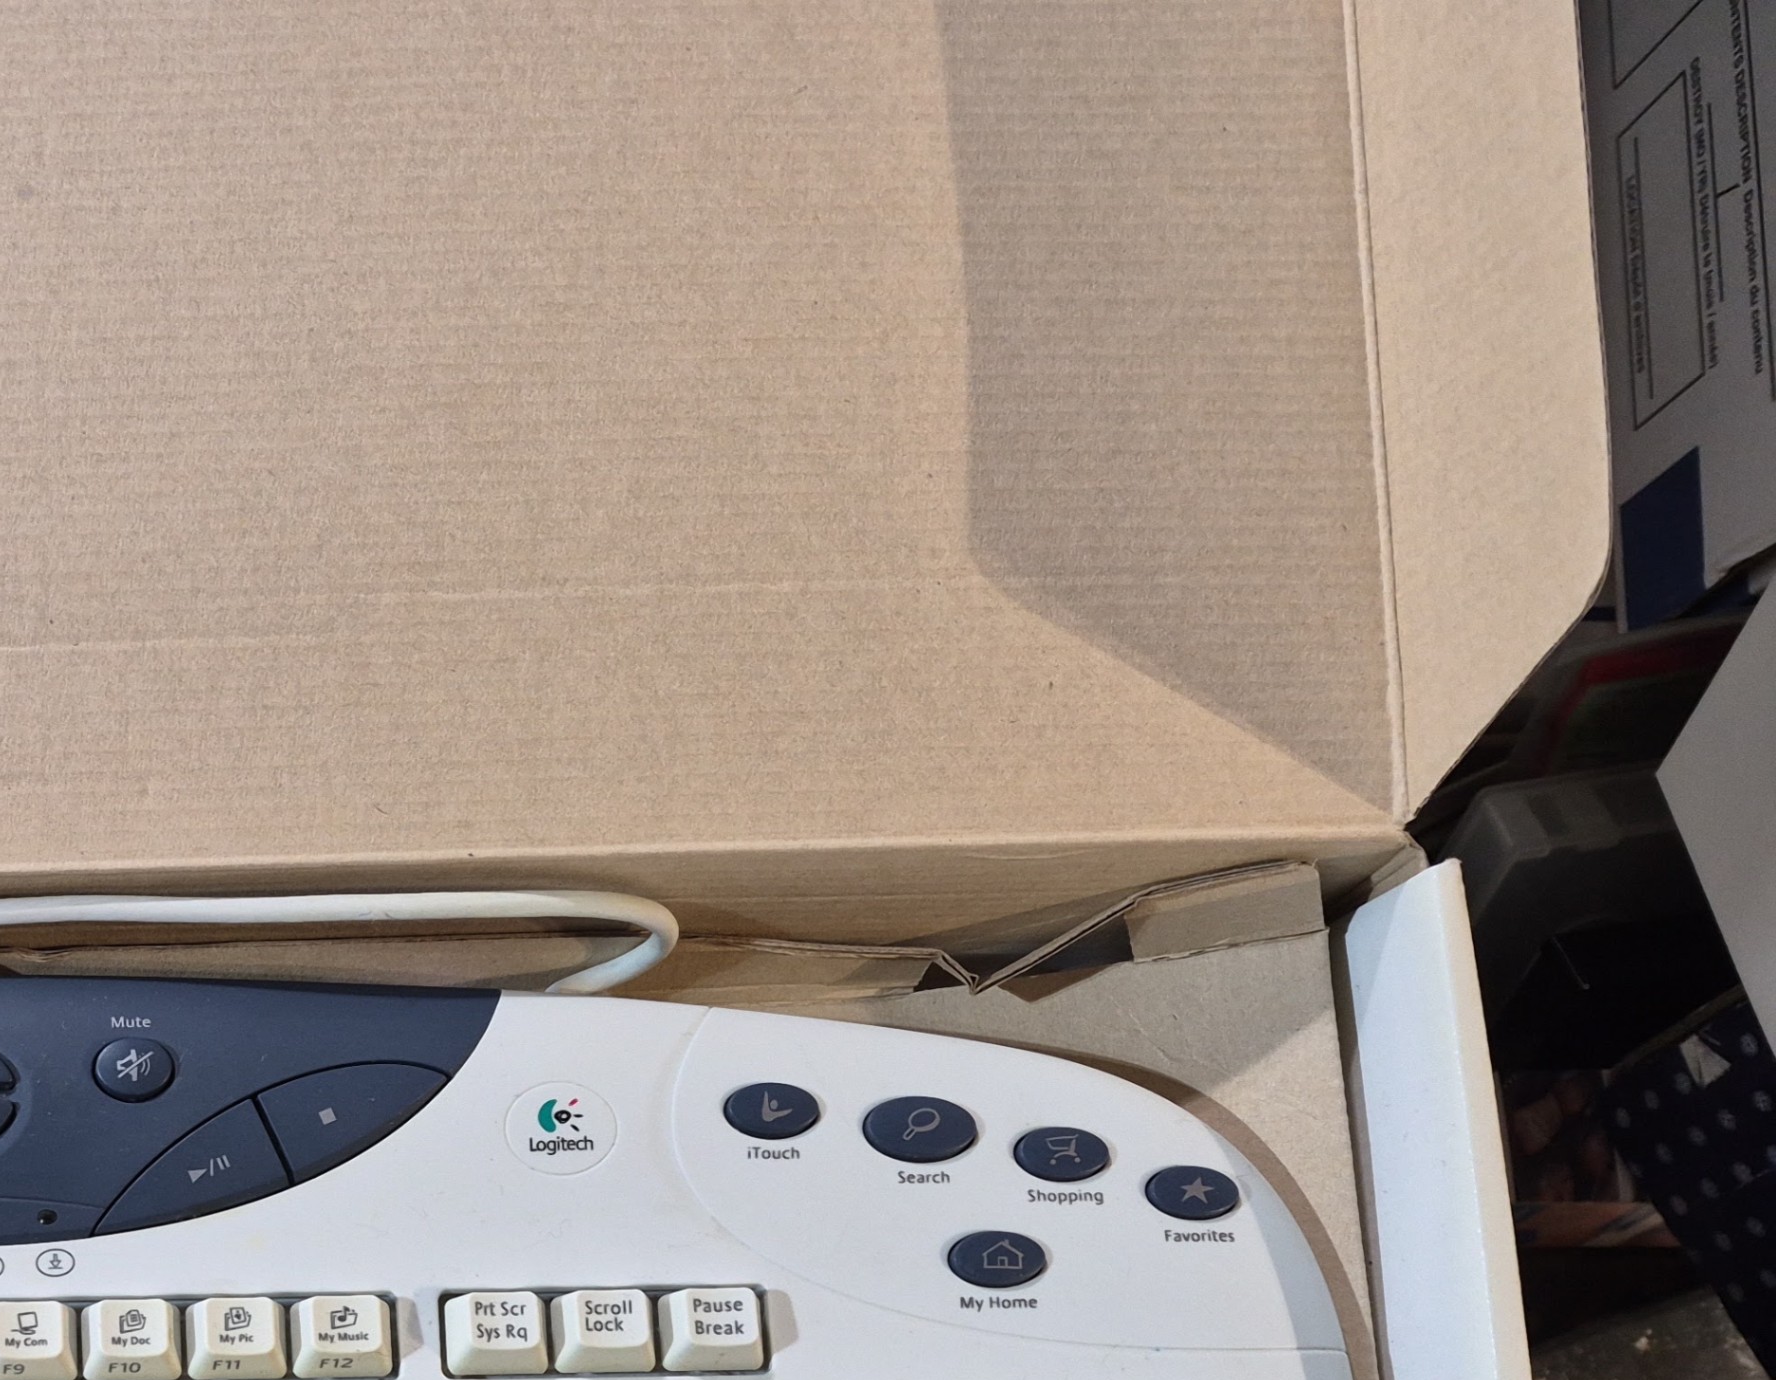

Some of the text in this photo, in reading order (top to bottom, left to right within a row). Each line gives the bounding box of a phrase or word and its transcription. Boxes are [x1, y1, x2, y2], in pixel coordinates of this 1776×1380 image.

[110, 1015, 152, 1028] Mute
[529, 1135, 594, 1156] Logitech
[747, 1146, 801, 1160] iTouch
[897, 1170, 951, 1184] Search
[1027, 1188, 1105, 1206] Shopping
[1163, 1229, 1236, 1243] Favorites
[474, 1300, 527, 1317] Prt Scr
[584, 1299, 633, 1316] Scroll
[692, 1297, 744, 1314] Pause
[959, 1296, 1038, 1313] My Home
[584, 1316, 624, 1333] Lock
[694, 1319, 745, 1336] Break
[218, 1333, 254, 1346] My Pic
[317, 1331, 369, 1344] My Music
[476, 1322, 528, 1343] Sys Rq
[4, 1336, 48, 1349] My Com
[111, 1335, 151, 1348] My Doc
[2, 1363, 26, 1376] F9
[108, 1361, 142, 1374] F10
[212, 1359, 241, 1371] F11
[319, 1357, 354, 1369] F12
